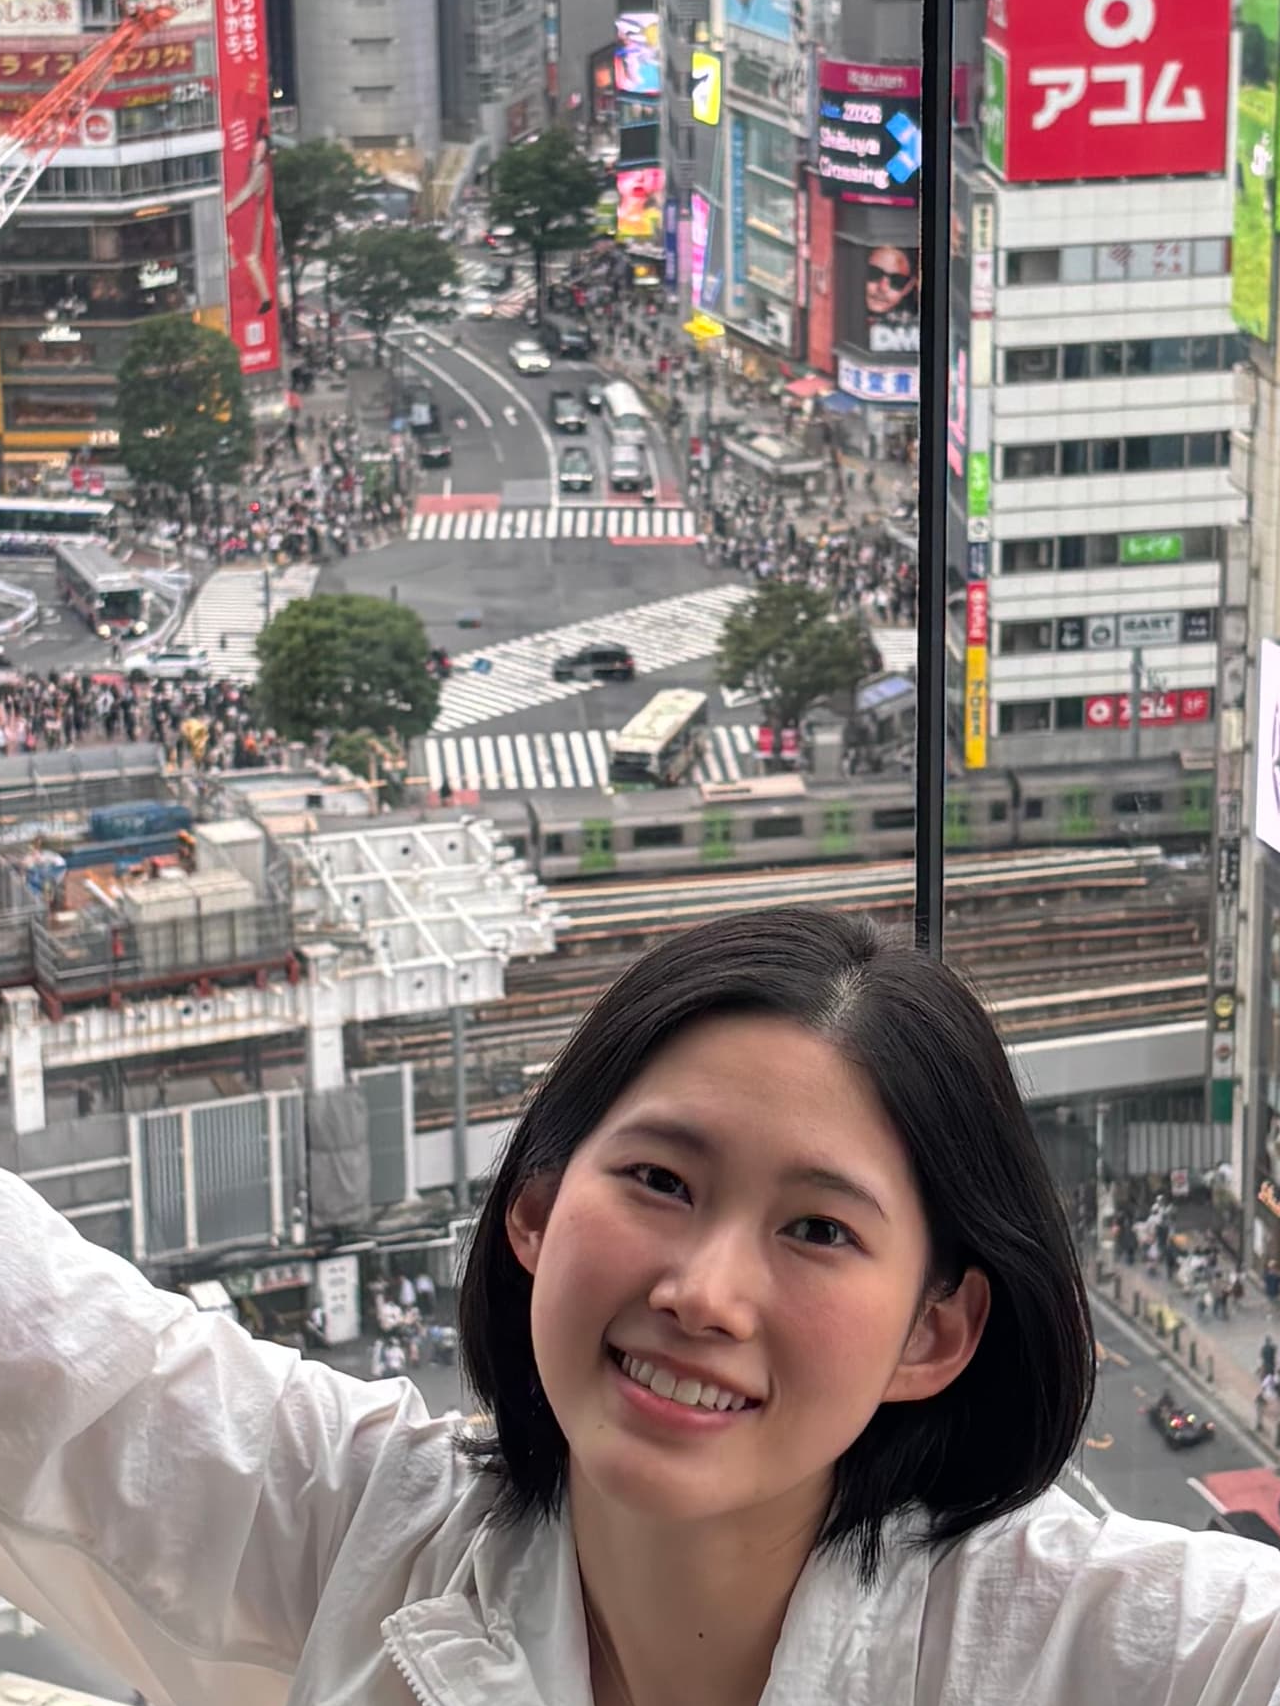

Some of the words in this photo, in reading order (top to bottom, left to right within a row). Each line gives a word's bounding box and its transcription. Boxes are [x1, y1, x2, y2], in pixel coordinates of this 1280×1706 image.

[1028, 59, 1206, 131] アコム
[820, 126, 880, 158] Shibuya
[820, 156, 889, 189] Crossing
